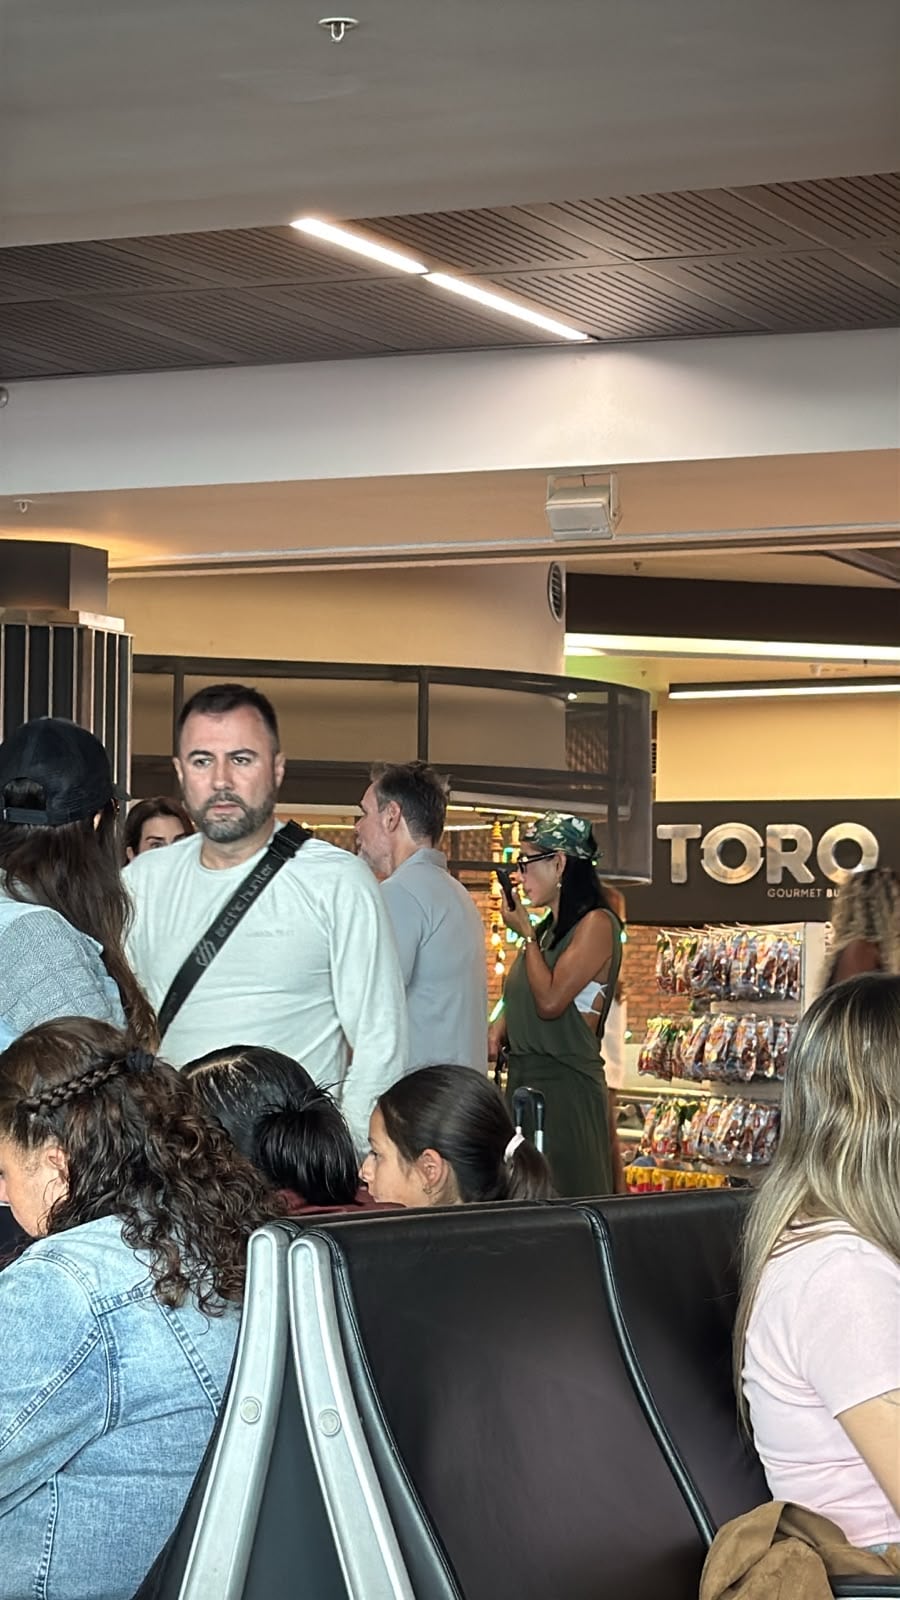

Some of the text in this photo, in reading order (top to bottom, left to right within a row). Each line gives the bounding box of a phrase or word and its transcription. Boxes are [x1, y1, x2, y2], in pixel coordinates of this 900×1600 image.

[656, 822, 879, 884] TORO
[239, 863, 274, 902] hunter
[767, 888, 822, 898] GOURMET
